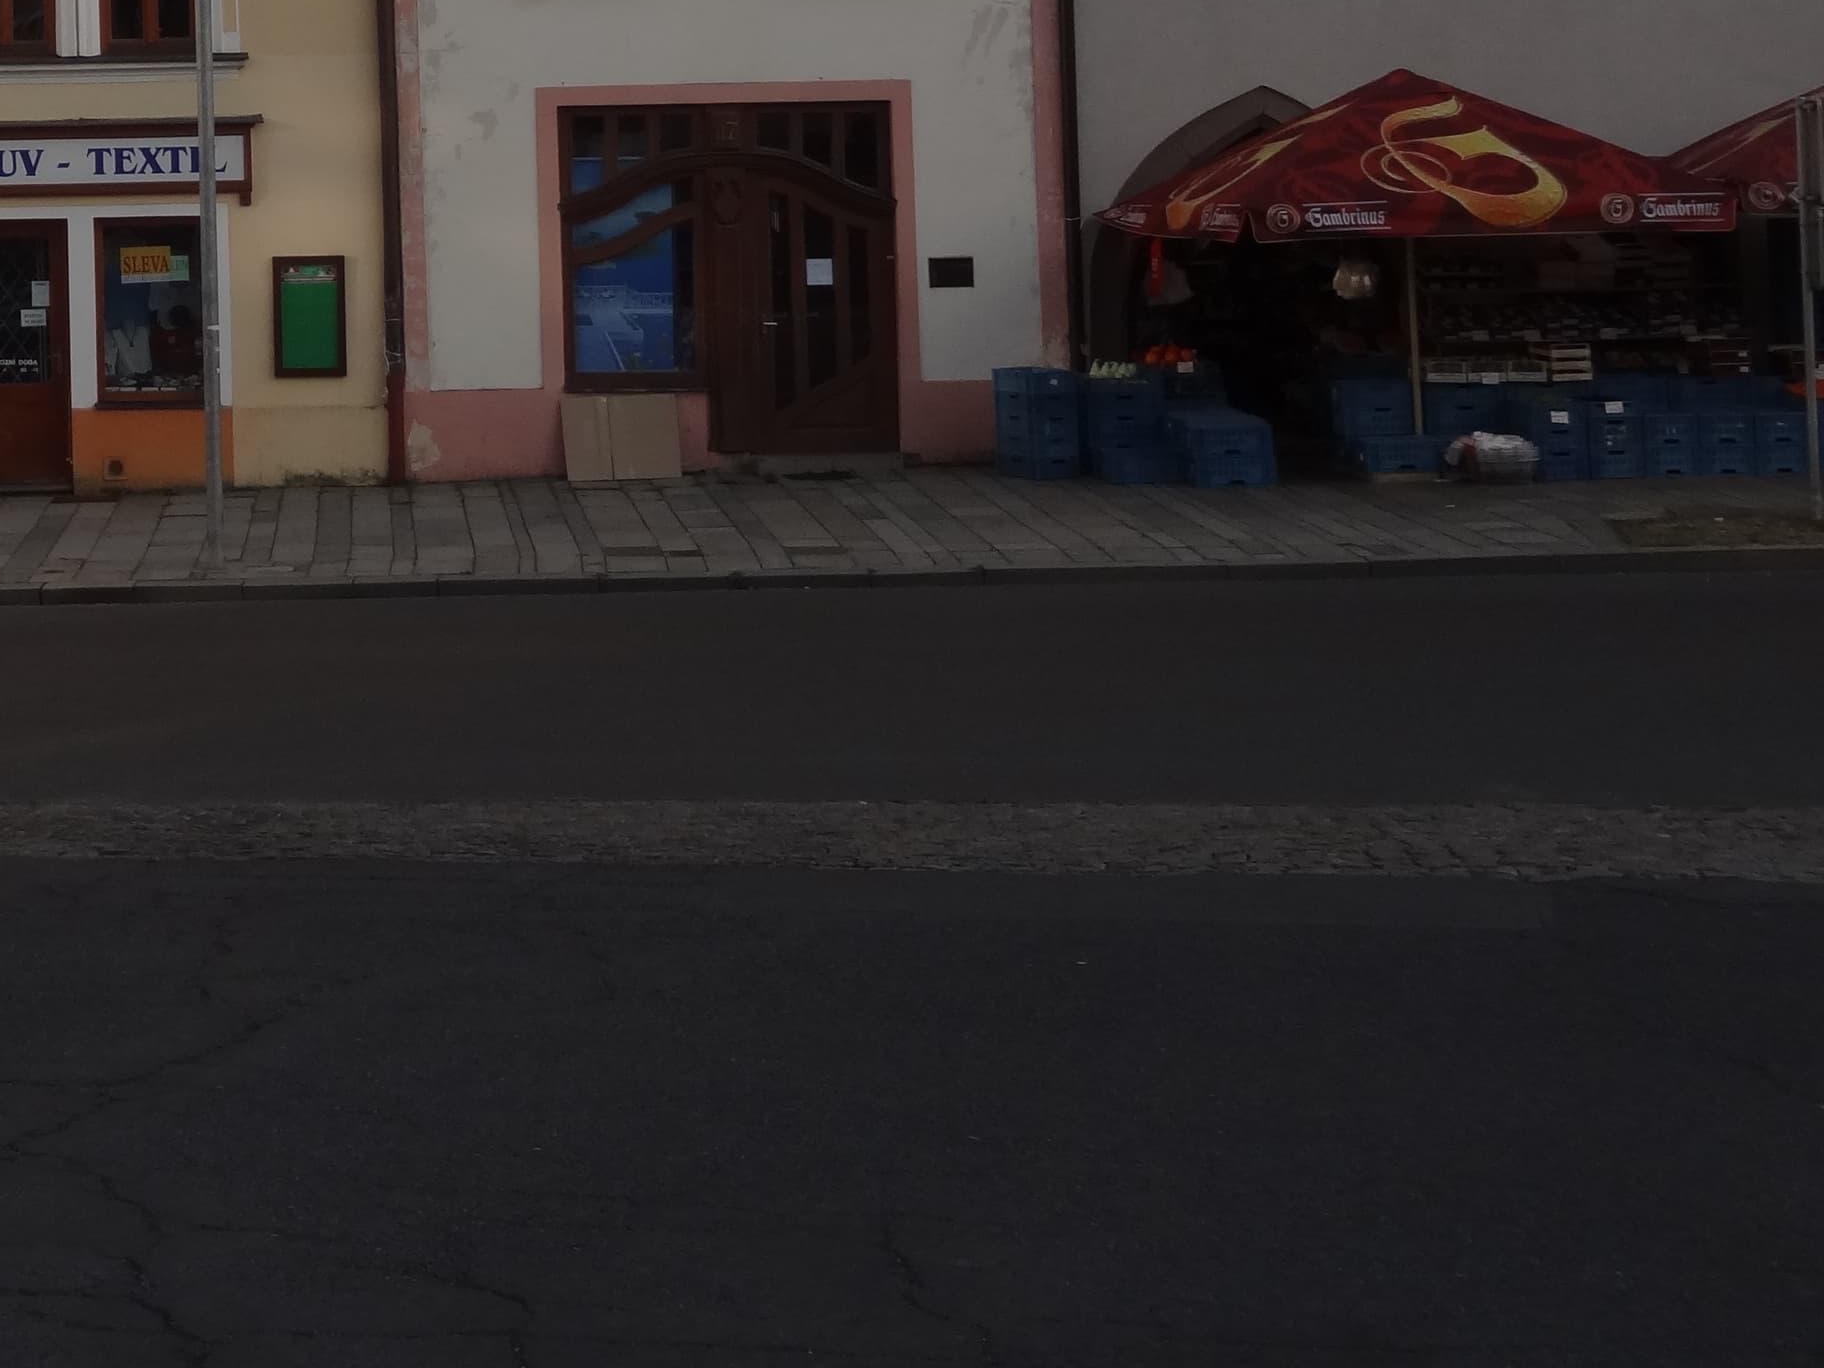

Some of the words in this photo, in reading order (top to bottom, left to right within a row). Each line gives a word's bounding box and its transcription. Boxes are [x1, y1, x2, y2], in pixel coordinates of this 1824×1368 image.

[1304, 207, 1386, 228] Gambrinus
[1639, 196, 1721, 219] Gambrinus
[123, 255, 170, 273] SLEVA
